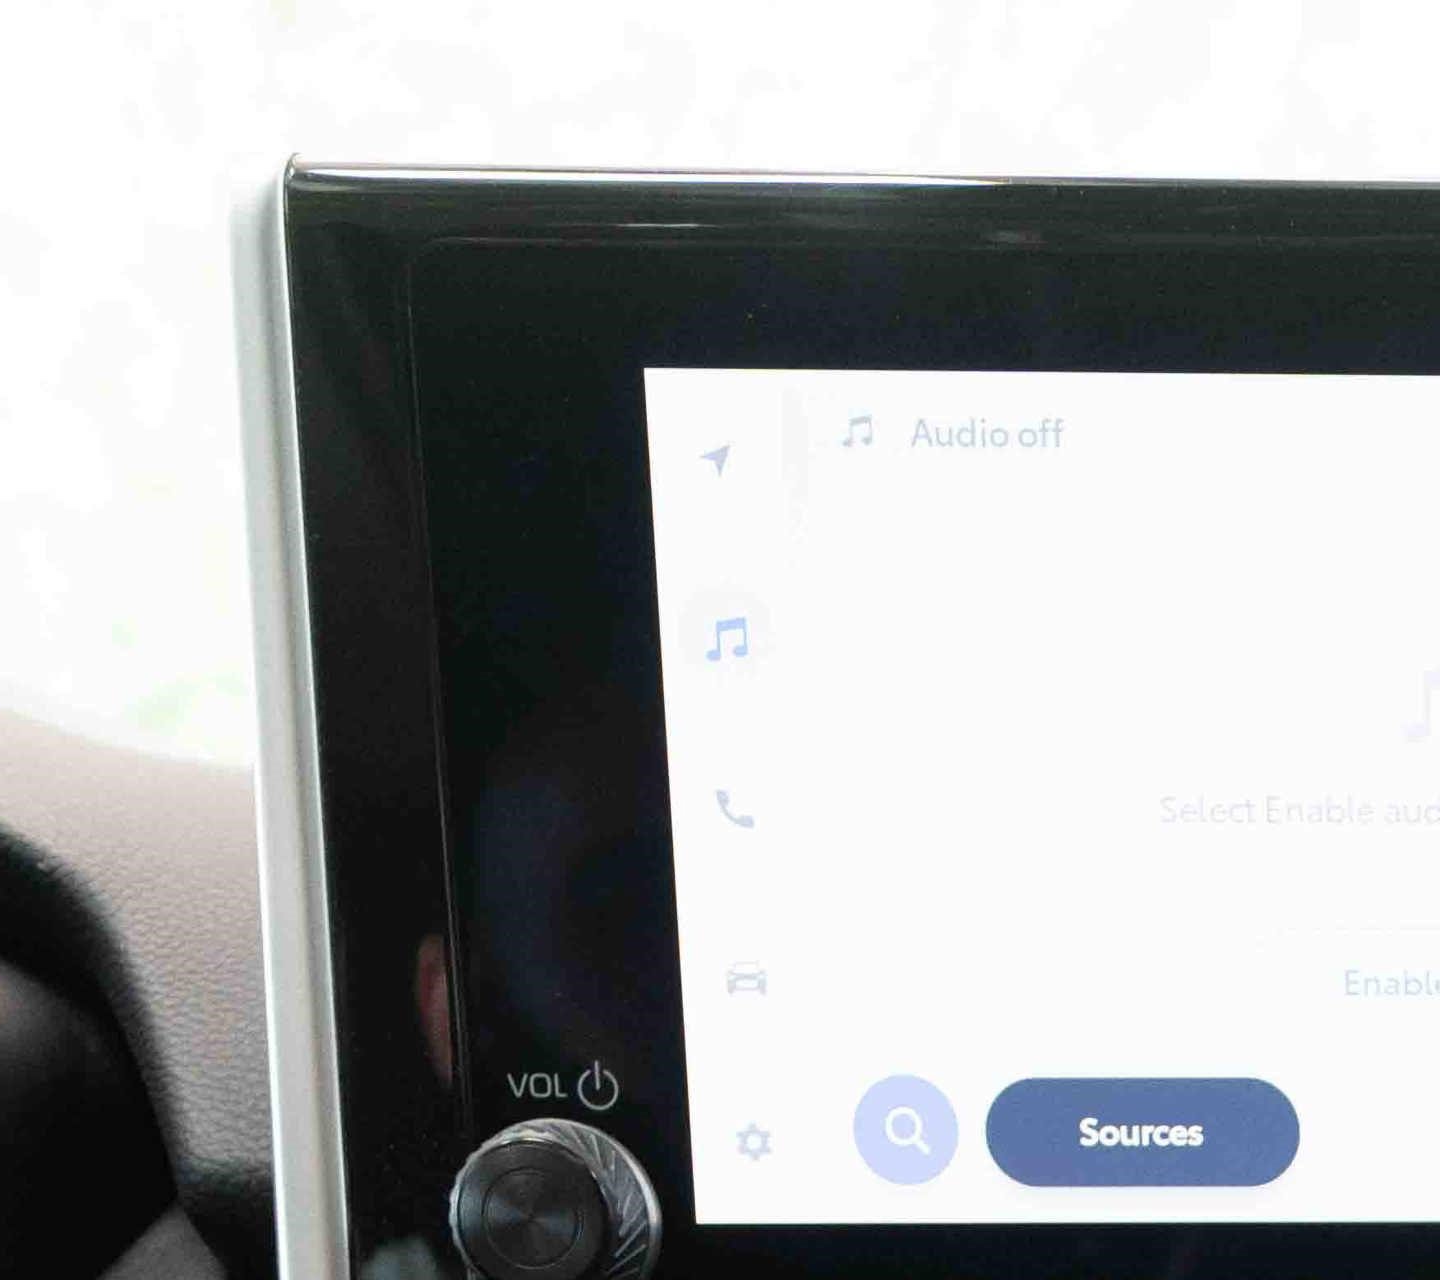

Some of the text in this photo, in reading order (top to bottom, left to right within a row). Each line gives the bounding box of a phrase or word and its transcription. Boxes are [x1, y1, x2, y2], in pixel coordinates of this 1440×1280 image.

[910, 417, 1064, 449] Audio off
[1159, 795, 1258, 825] Select
[1265, 794, 1375, 825] Enable
[506, 1071, 568, 1100] VOL
[1079, 1117, 1205, 1148] Sources
